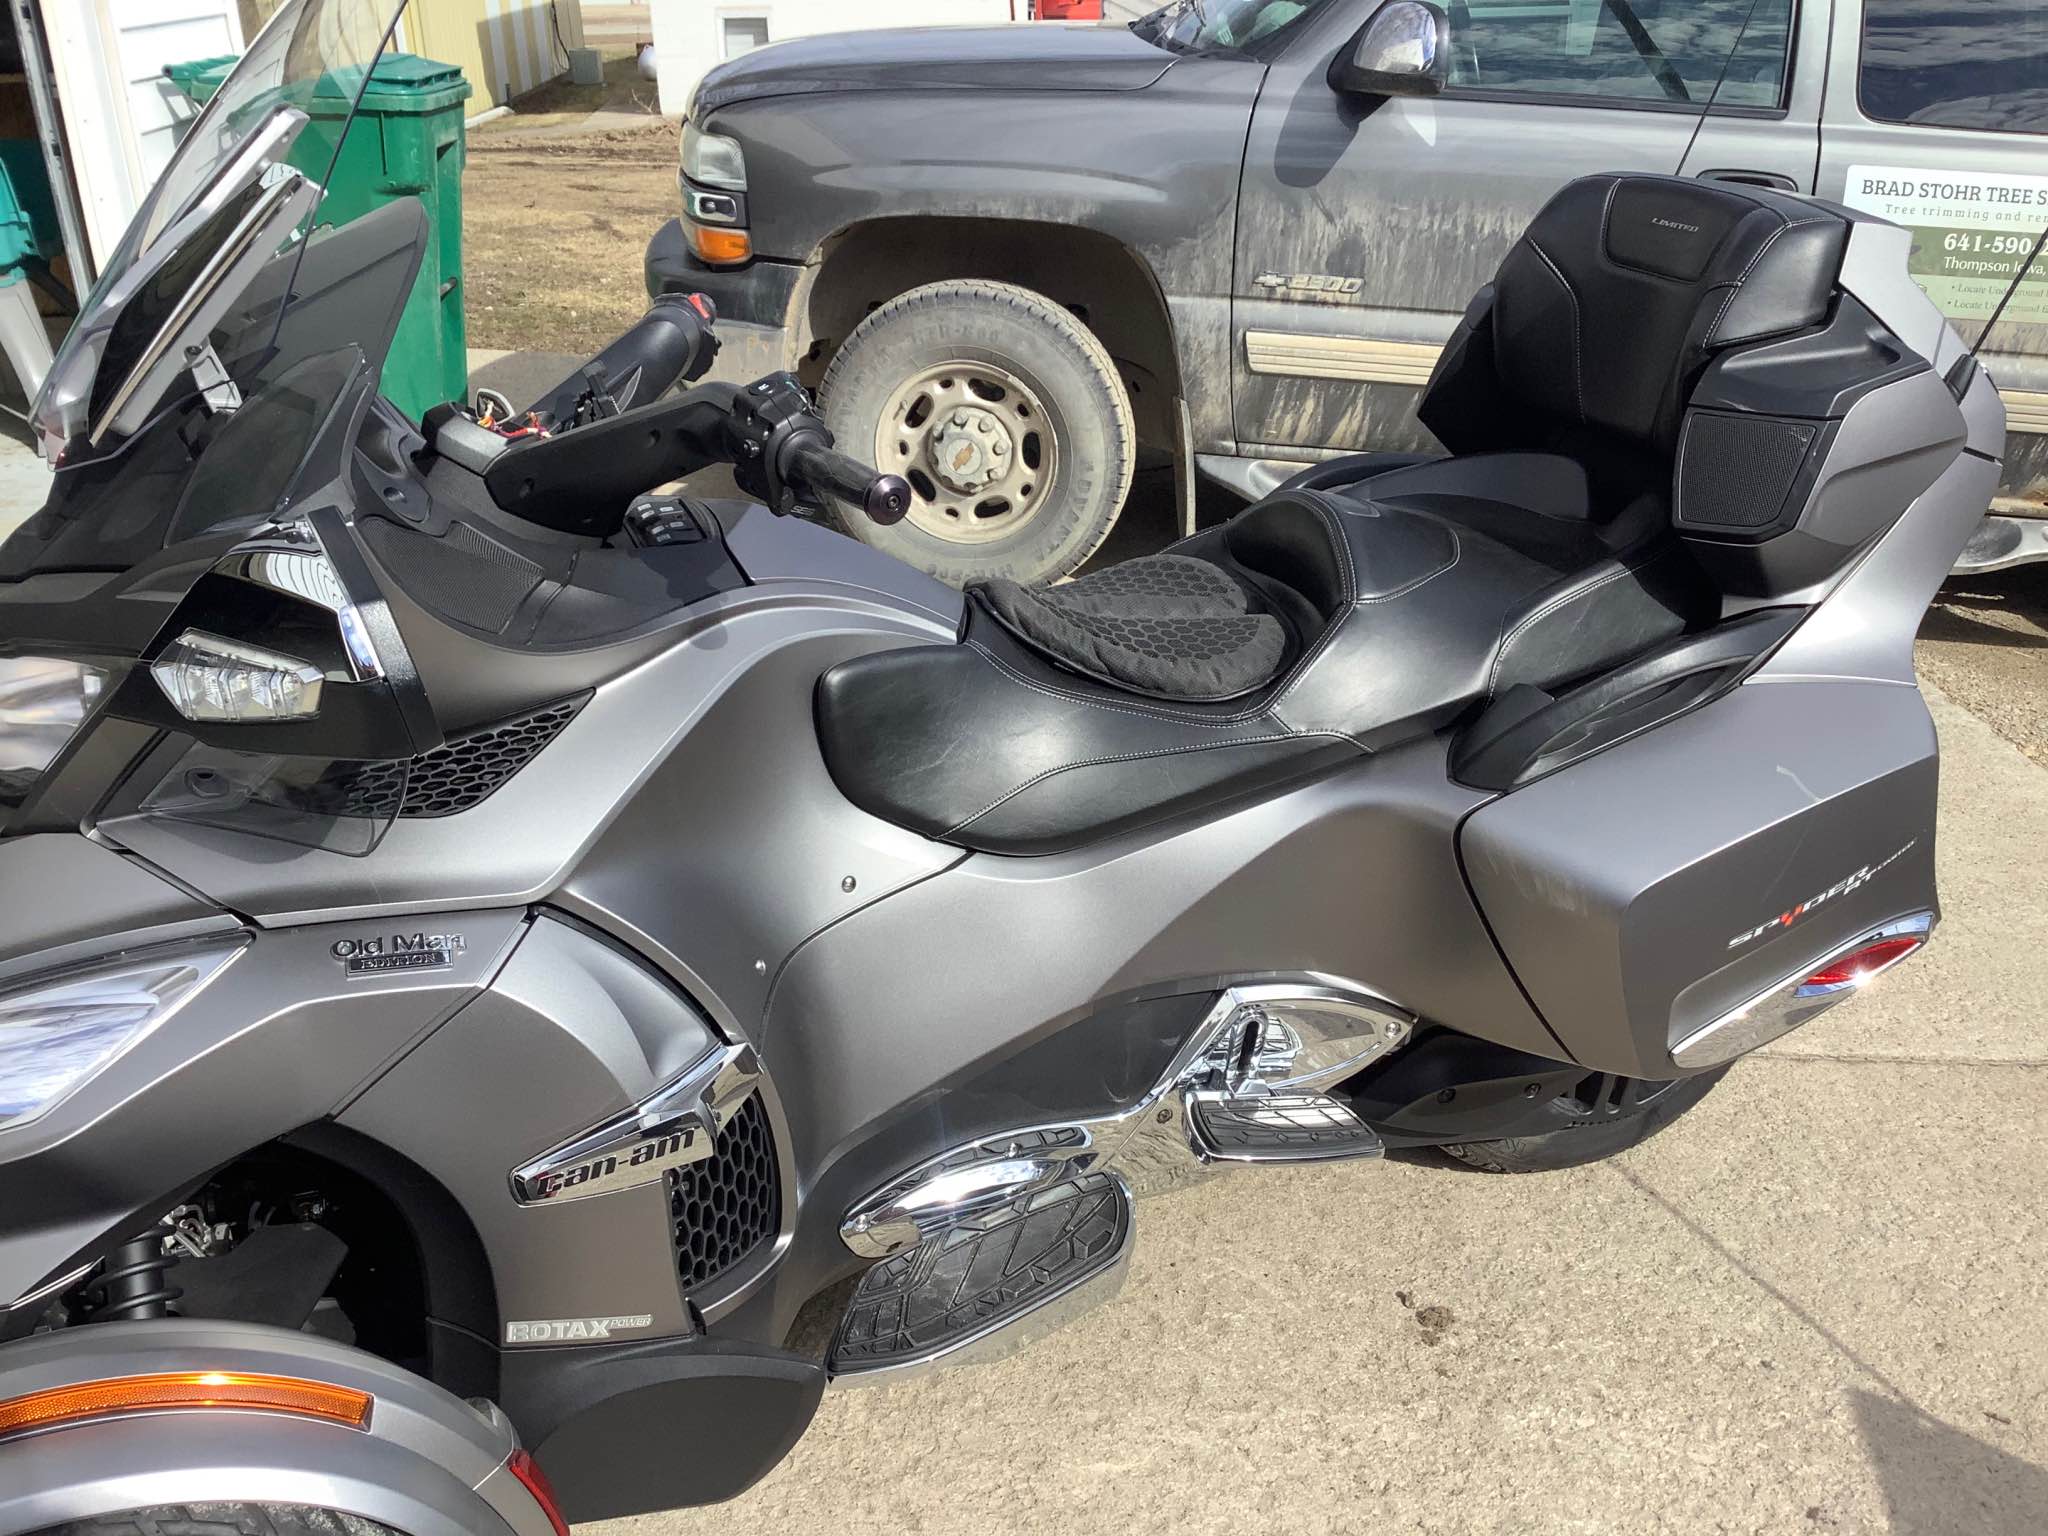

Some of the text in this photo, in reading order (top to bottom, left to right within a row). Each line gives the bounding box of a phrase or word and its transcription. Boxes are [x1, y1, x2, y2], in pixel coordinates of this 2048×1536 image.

[1861, 179, 1915, 197] BRAD
[1919, 183, 1981, 201] STOHR
[1986, 187, 2033, 204] TREE
[1886, 204, 1916, 215] Tree
[1922, 205, 1989, 222] trimming
[1995, 211, 2021, 221] and
[1944, 256, 2010, 274] Thompson
[1727, 863, 1870, 949] SPYDER
[331, 932, 466, 957] Old Man
[360, 953, 436, 969] EDITION
[507, 1316, 652, 1342] ROTAX POWER
